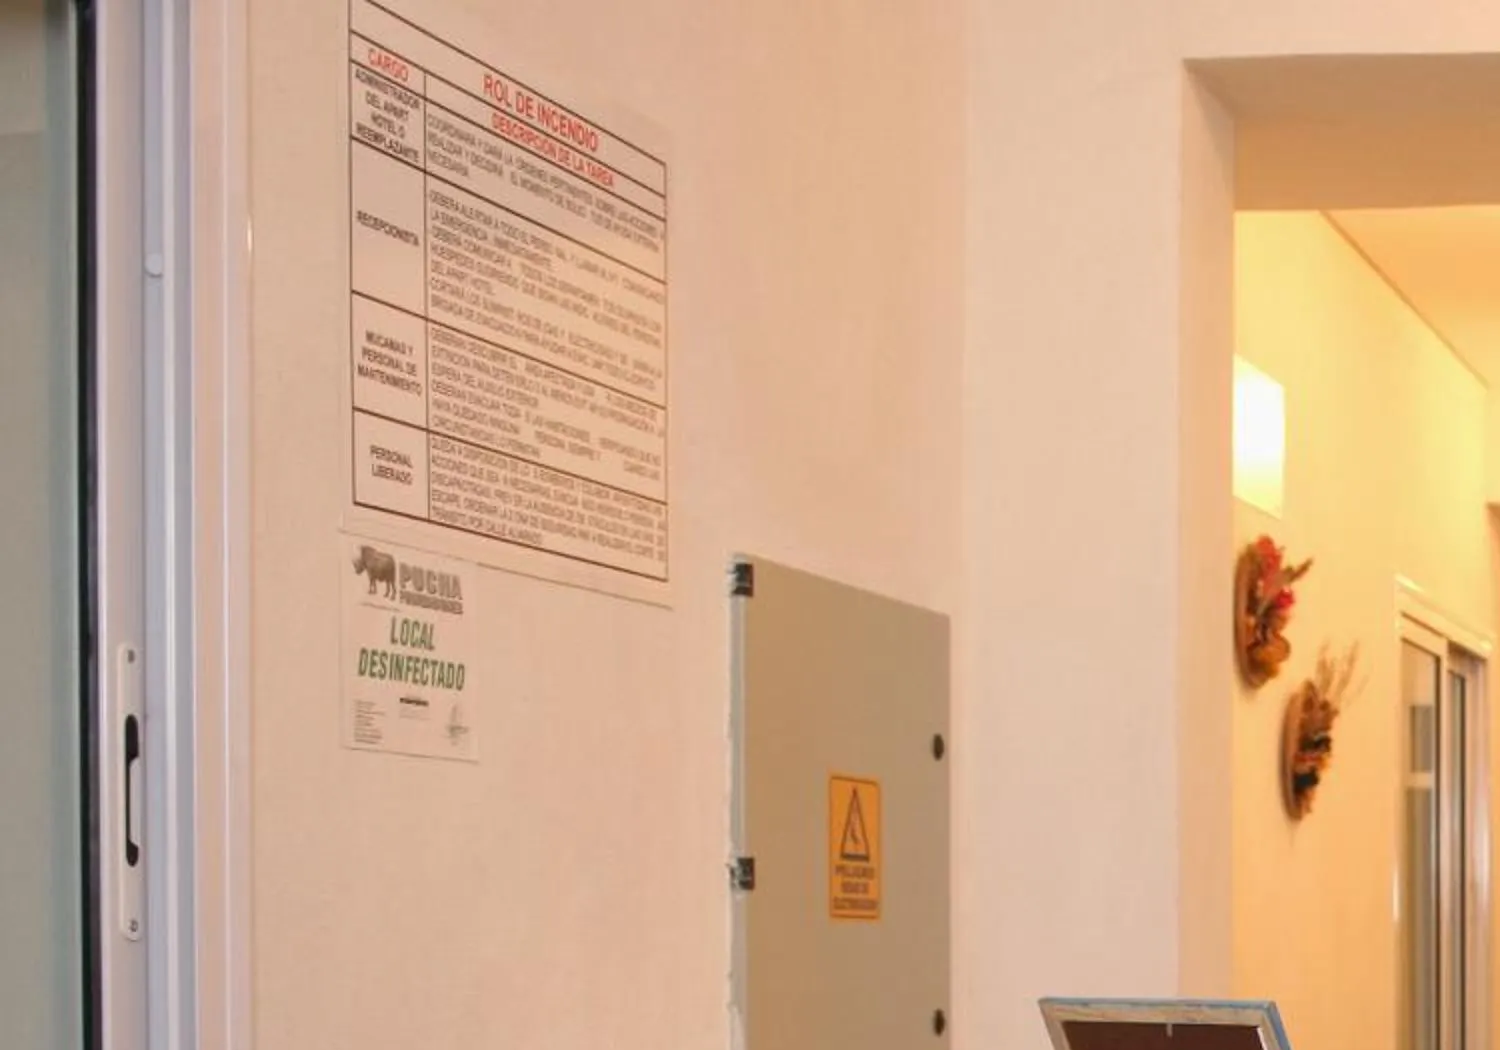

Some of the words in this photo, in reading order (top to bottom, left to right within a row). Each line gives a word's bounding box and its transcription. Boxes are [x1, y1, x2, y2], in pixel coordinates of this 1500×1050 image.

[368, 48, 409, 83] CARGO
[483, 72, 512, 107] ROL
[516, 90, 536, 120] DE
[537, 102, 598, 153] INCENDIO
[558, 147, 571, 166] DE
[573, 155, 585, 173] LA
[585, 162, 614, 188] TAREA
[370, 446, 413, 467] PERSONAL
[371, 464, 413, 485] LIBERADO
[390, 615, 435, 650] LOCAL
[358, 648, 465, 691] DESINFECTADO
